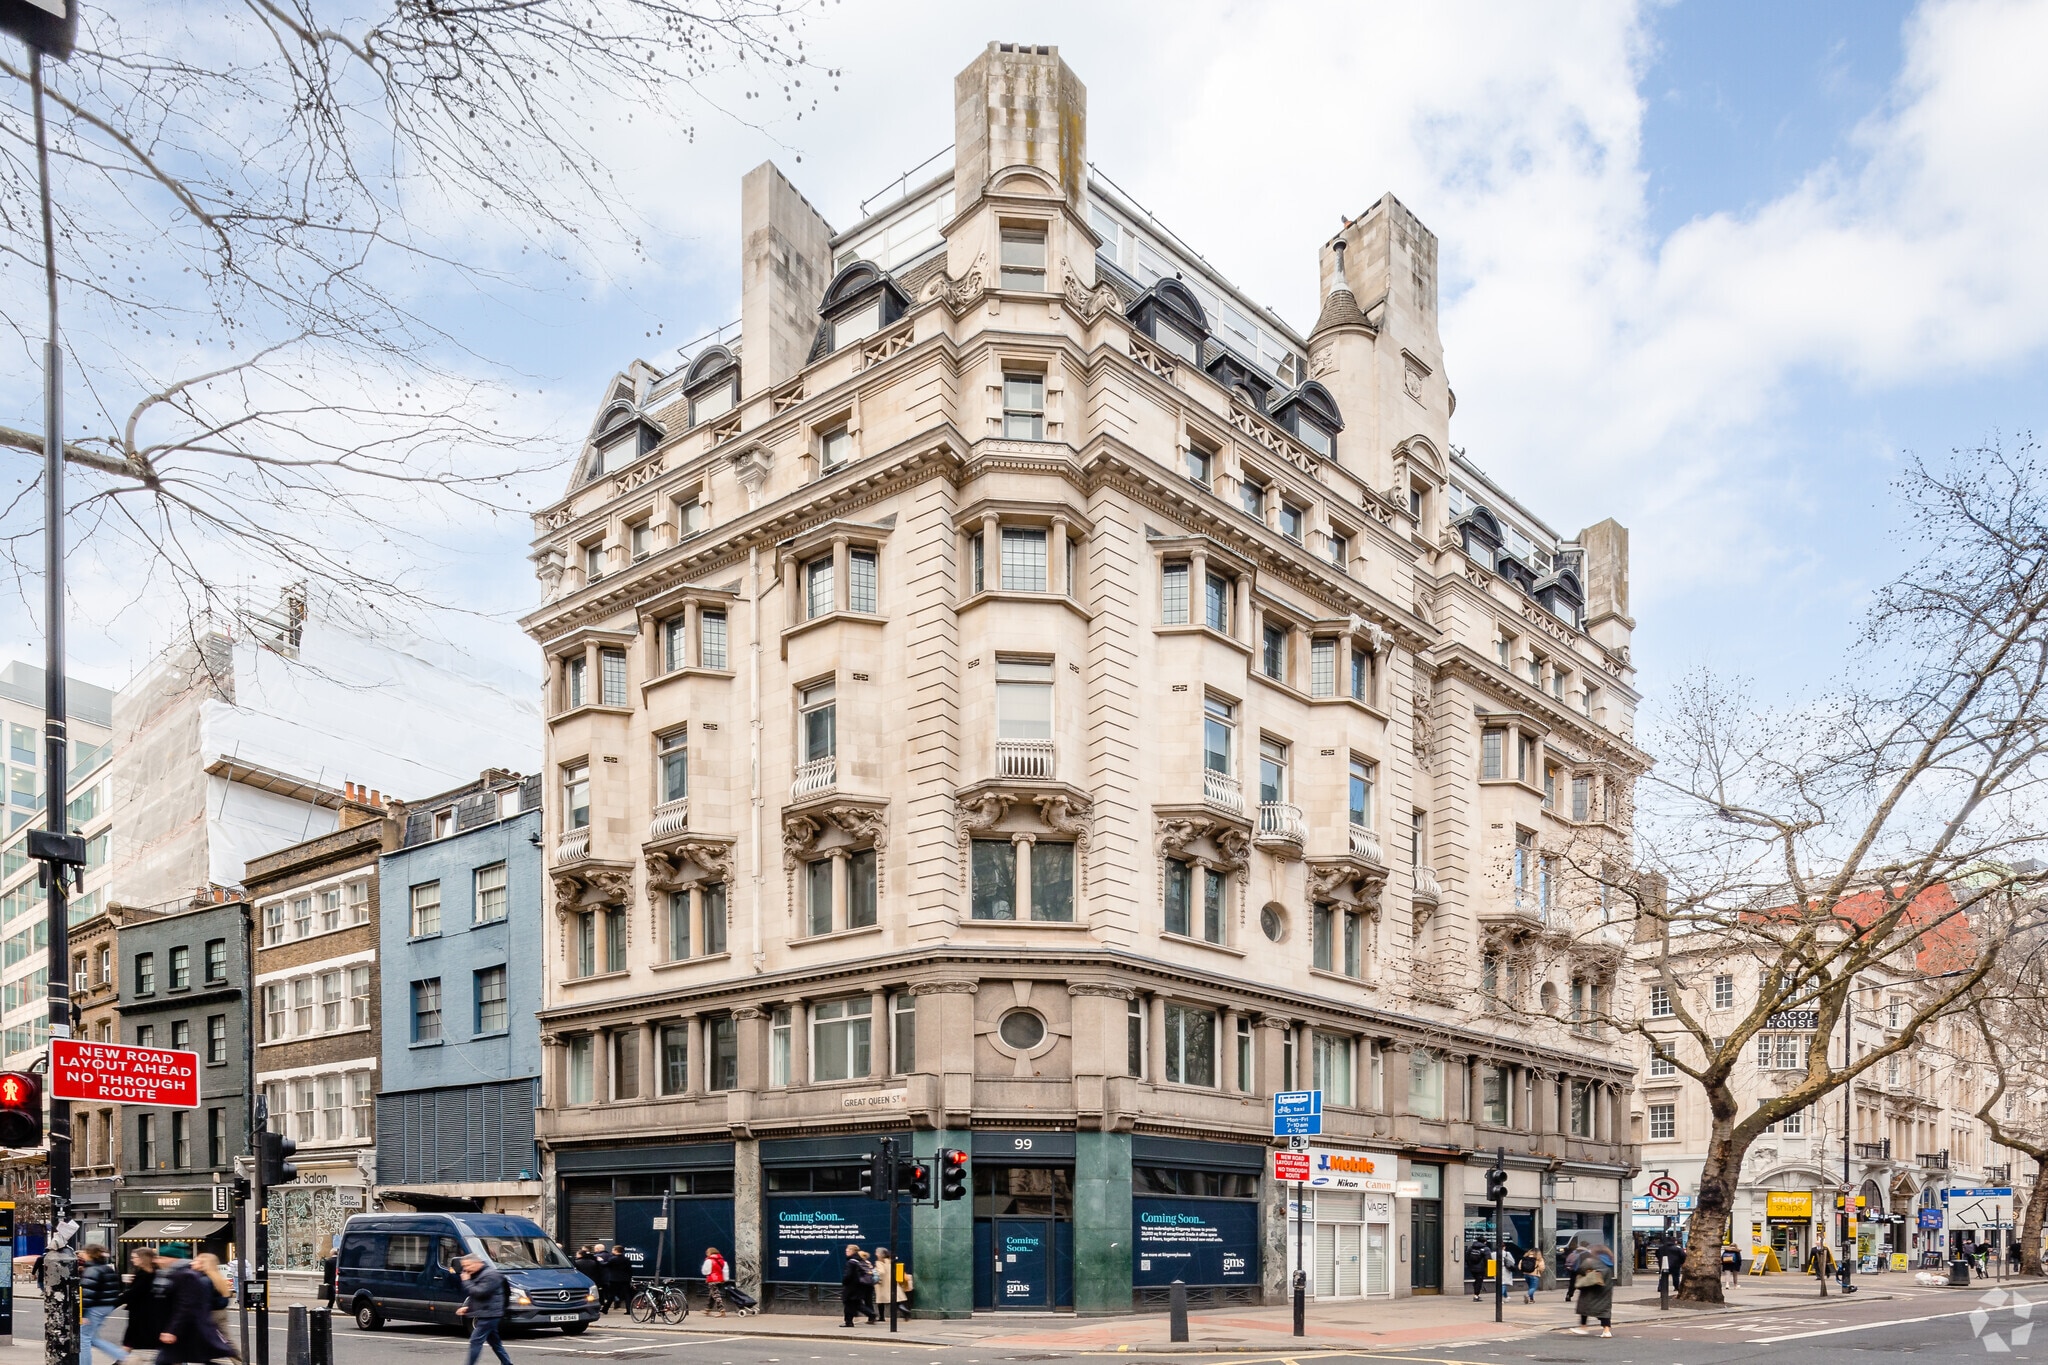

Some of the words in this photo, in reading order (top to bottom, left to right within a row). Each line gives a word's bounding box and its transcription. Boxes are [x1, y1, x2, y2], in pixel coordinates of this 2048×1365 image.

[1770, 1012, 1818, 1020] EACO
[1766, 1020, 1814, 1028] HOUSE
[80, 1046, 119, 1059] NEW
[126, 1050, 174, 1064] ROAD
[60, 1056, 128, 1071] LAYOUT
[133, 1064, 192, 1077] AHEAD
[66, 1072, 94, 1082] NO
[100, 1074, 186, 1090] THROUGH
[99, 1086, 156, 1099] ROUTE
[844, 1098, 866, 1106] GREAT
[868, 1096, 890, 1106] QUEEN
[1014, 1139, 1032, 1150] 99
[1318, 1154, 1374, 1174] J.Mobile
[304, 1172, 328, 1184] Salon
[1337, 1179, 1358, 1188] Nikon
[1366, 1181, 1391, 1190] Canon
[1772, 1196, 1808, 1205] snappy
[1367, 1202, 1387, 1212] VAPE
[779, 1211, 814, 1224] Coming
[1141, 1212, 1177, 1226] Coming
[1006, 1237, 1039, 1245] Coming
[1224, 1258, 1245, 1270] gms
[1007, 1284, 1030, 1293] gms
